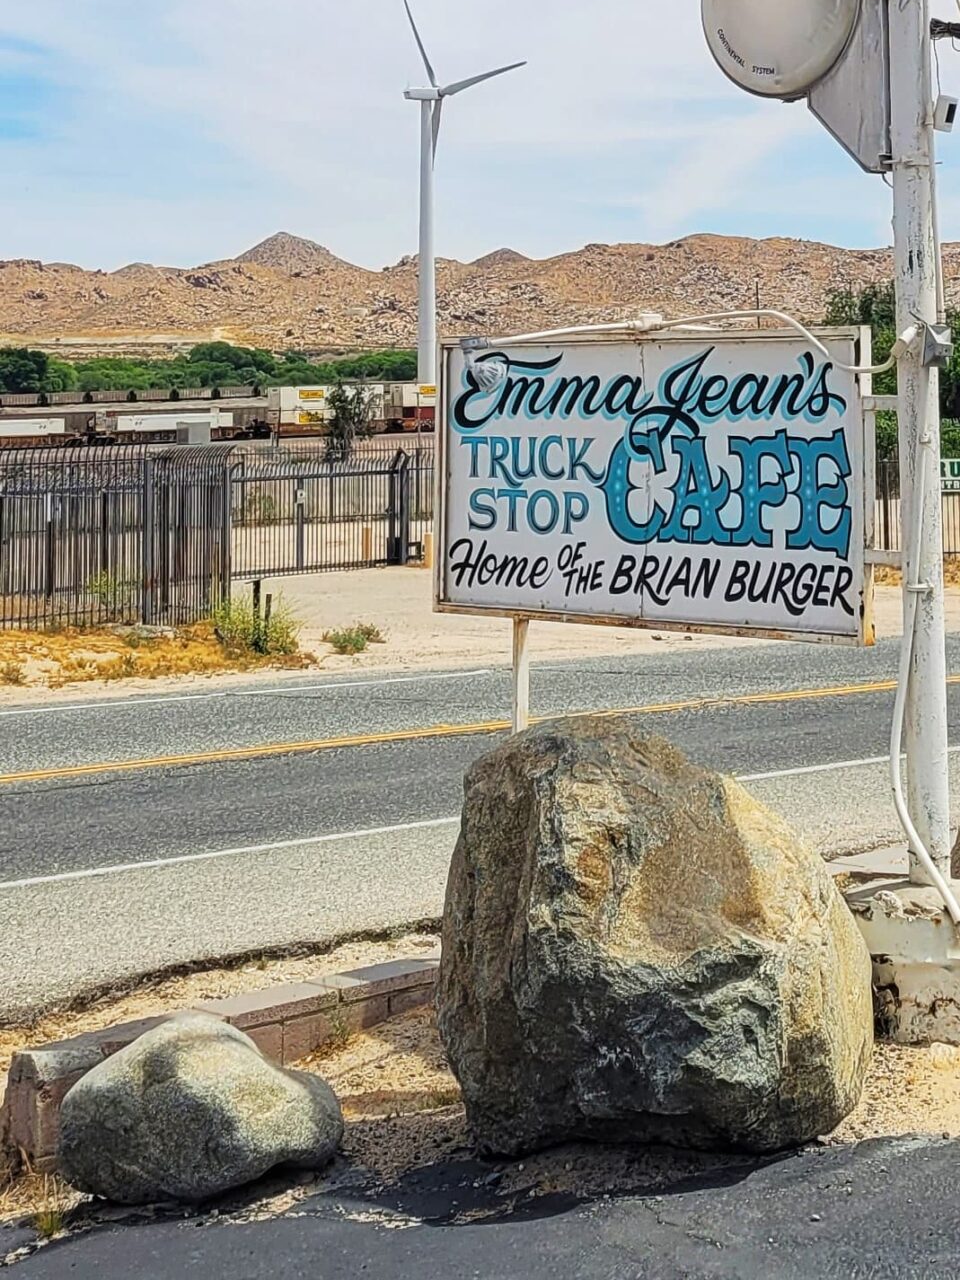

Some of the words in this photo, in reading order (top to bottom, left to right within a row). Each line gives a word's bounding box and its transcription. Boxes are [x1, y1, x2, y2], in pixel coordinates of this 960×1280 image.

[454, 351, 651, 428] Emma
[628, 345, 847, 455] Jean's
[460, 436, 604, 488] TRUCK
[468, 487, 589, 535] STOP
[601, 428, 852, 560] CAFE
[449, 538, 553, 589] Home
[558, 542, 586, 570] OF
[563, 560, 605, 596] THE
[609, 554, 720, 606] BRIAN
[724, 560, 855, 616] BURGER
